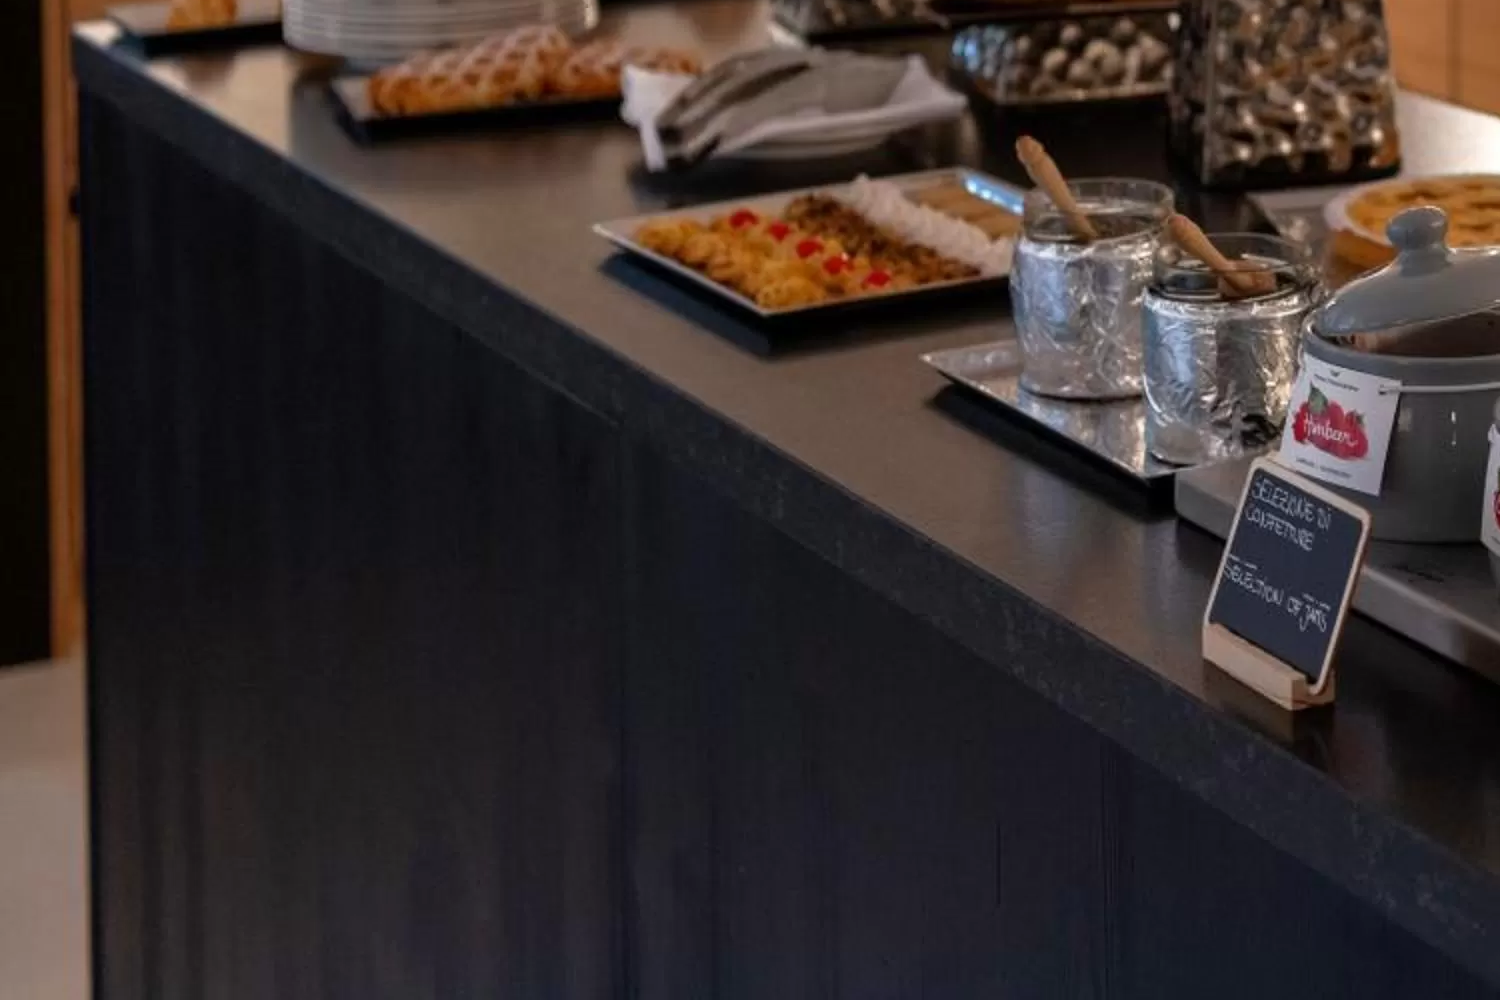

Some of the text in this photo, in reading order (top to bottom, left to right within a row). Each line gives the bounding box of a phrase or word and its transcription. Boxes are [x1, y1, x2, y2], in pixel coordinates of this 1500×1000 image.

[1251, 475, 1315, 523] SELEZIONE
[1223, 555, 1331, 633] SELECTION OF JAMS
